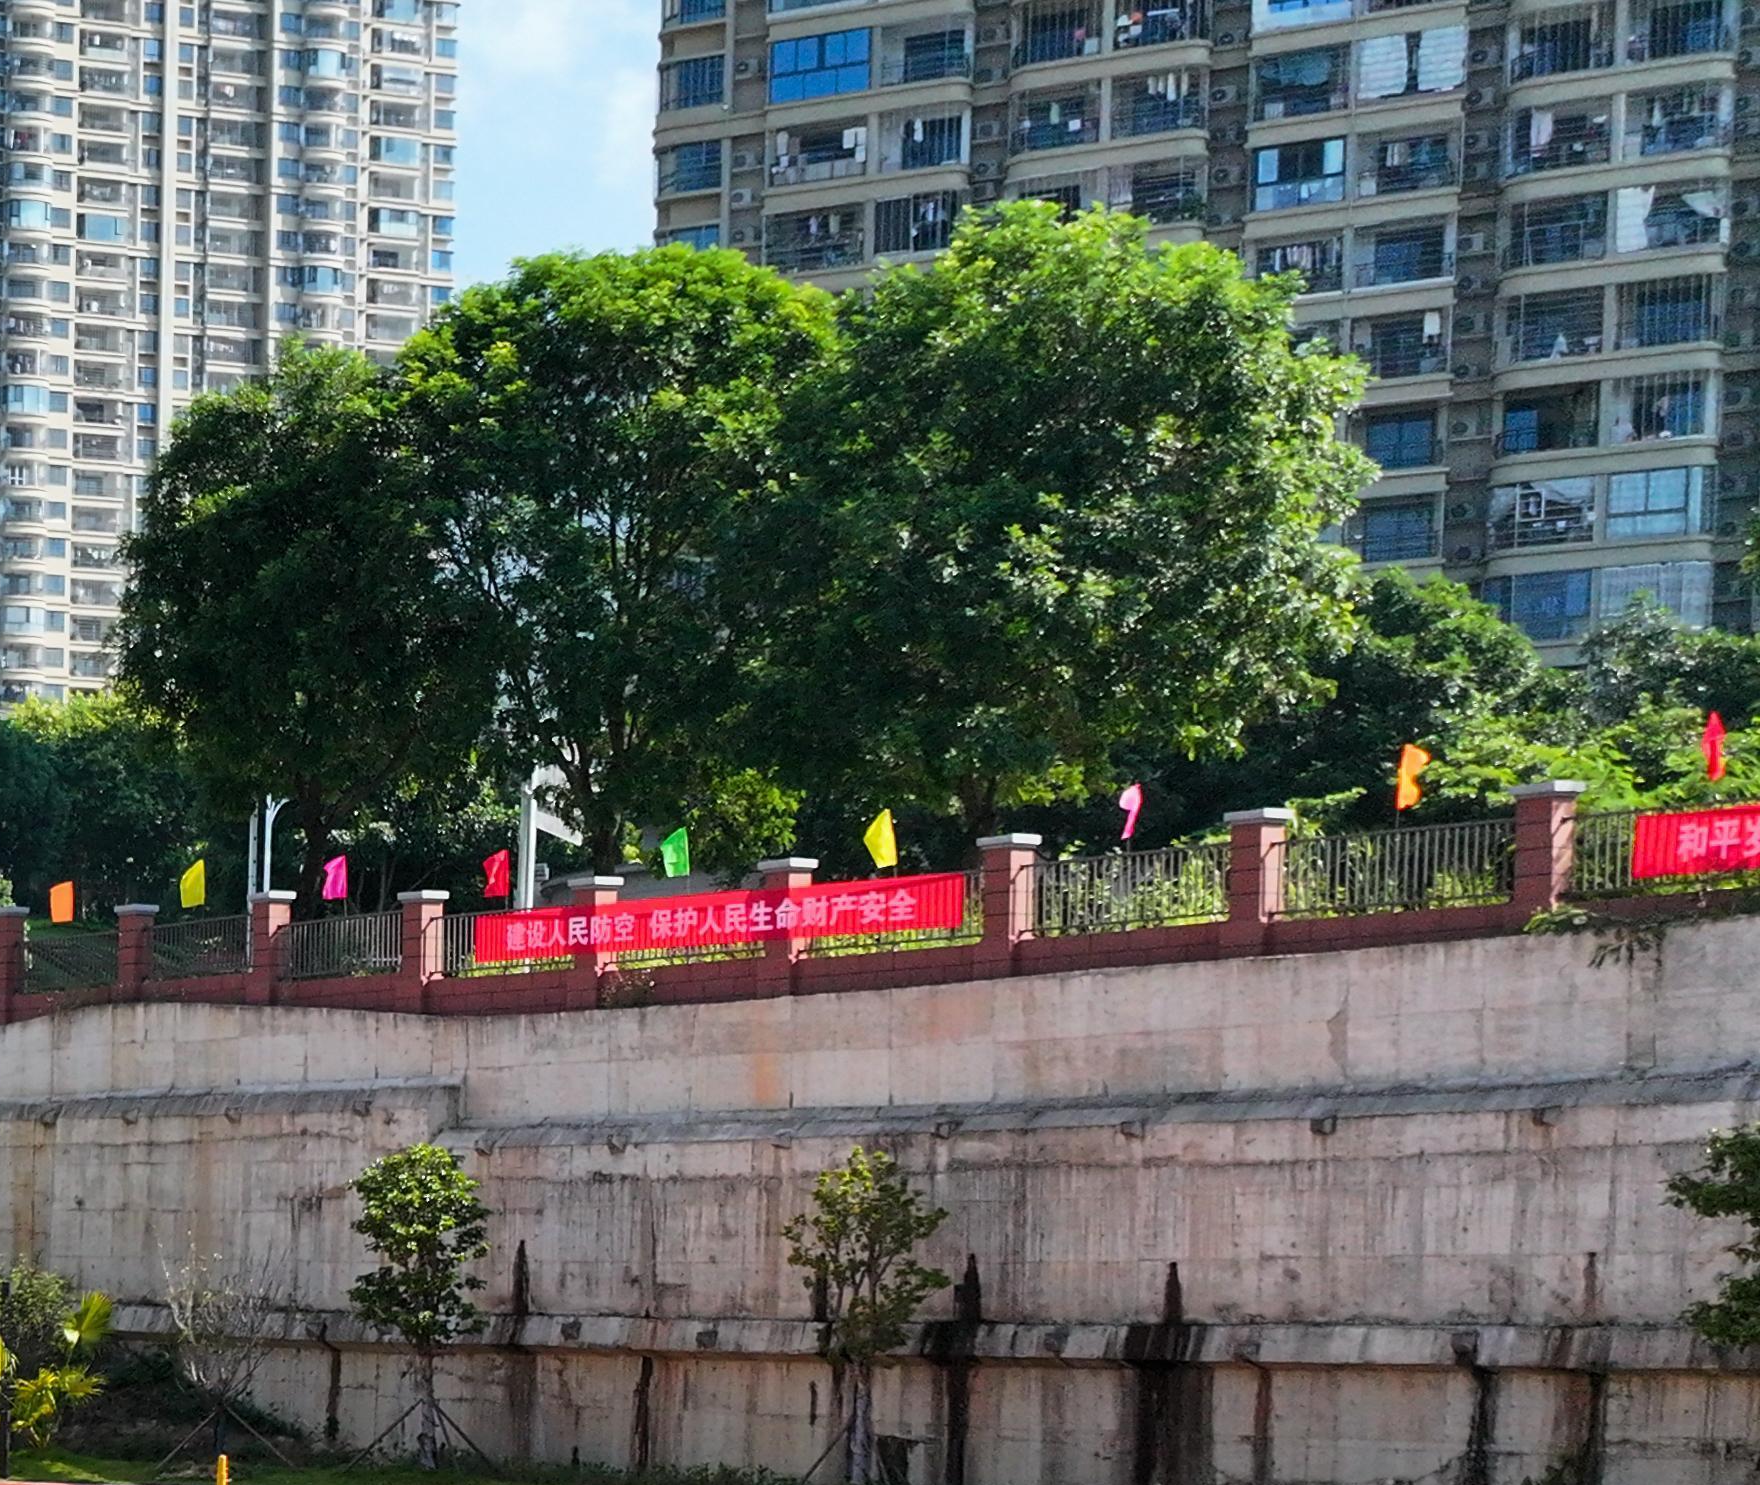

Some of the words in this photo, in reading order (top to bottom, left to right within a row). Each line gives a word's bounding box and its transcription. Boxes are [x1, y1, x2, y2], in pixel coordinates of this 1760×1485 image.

[506, 911, 635, 951] 建设人民防空
[649, 888, 918, 940] 保护人民生命财产安全
